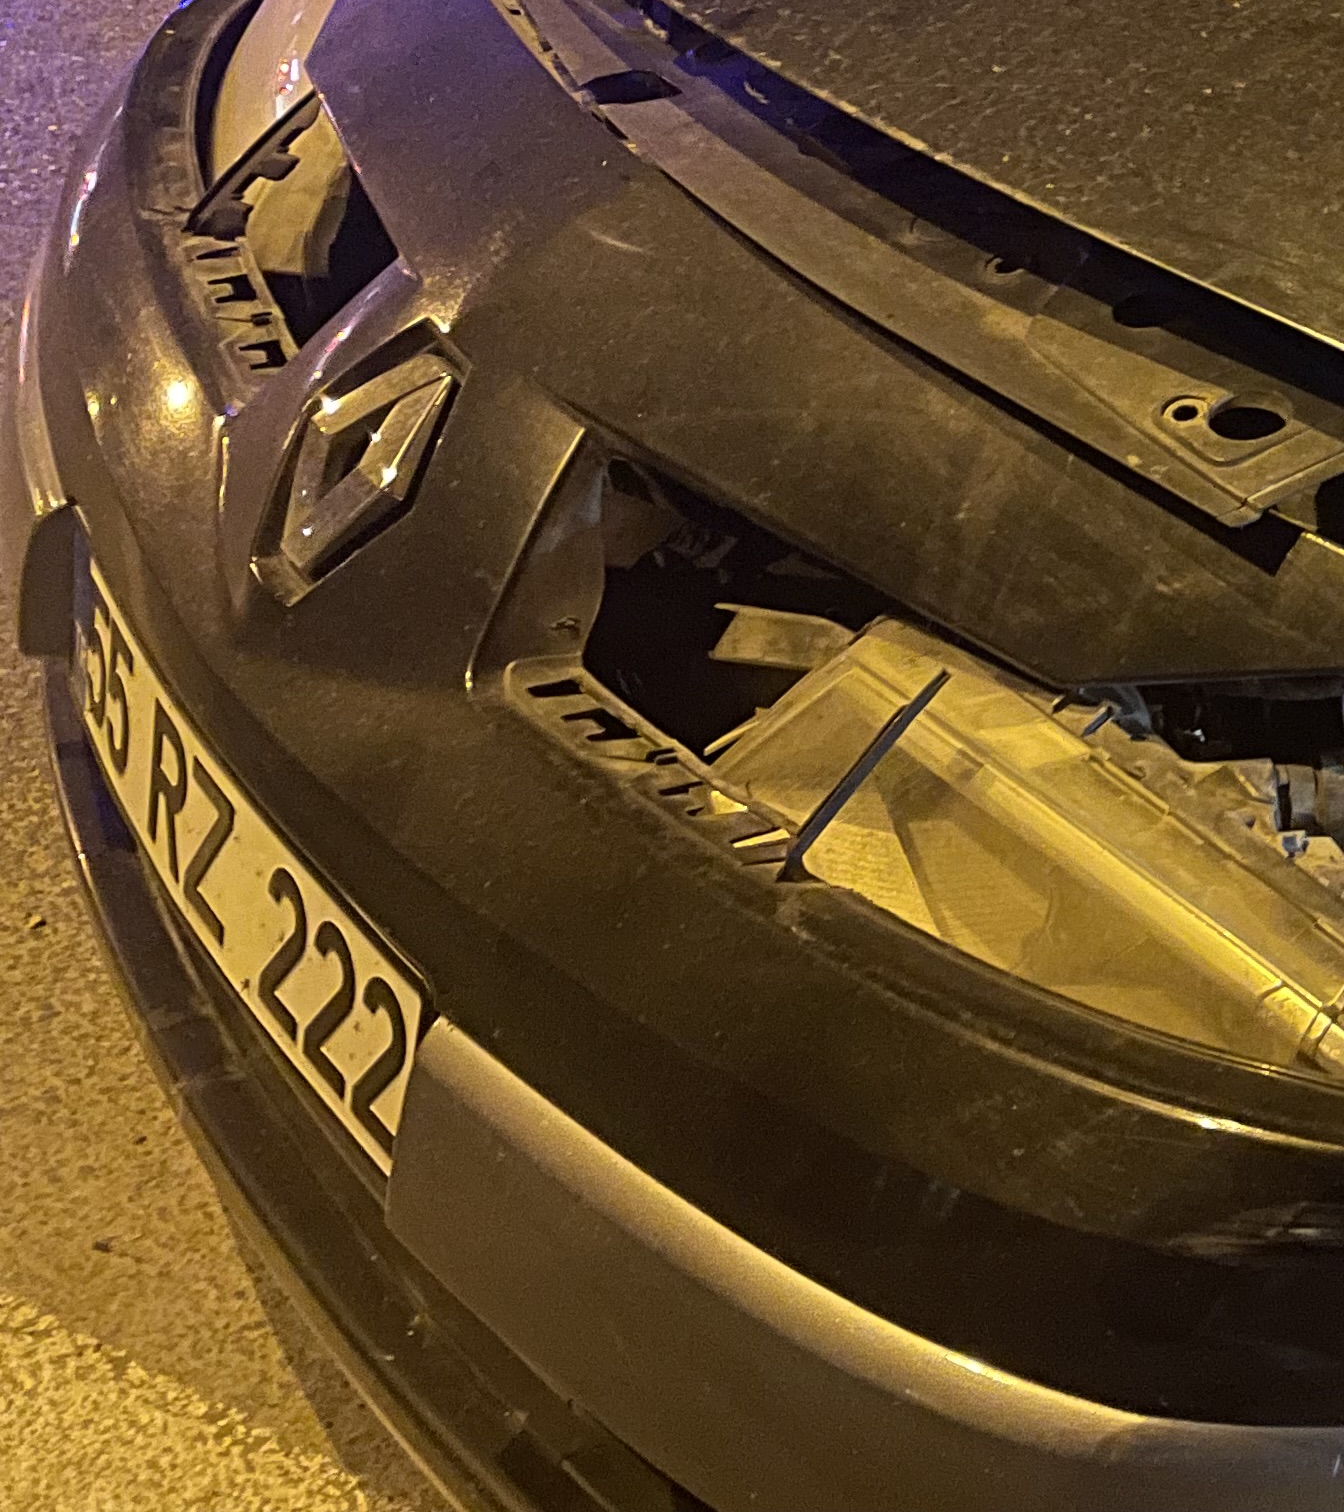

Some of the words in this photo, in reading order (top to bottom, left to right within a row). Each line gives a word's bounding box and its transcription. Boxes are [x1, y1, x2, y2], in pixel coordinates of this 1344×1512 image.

[85, 588, 135, 779] 55
[146, 696, 236, 947] RZ
[257, 866, 408, 1150] 222
